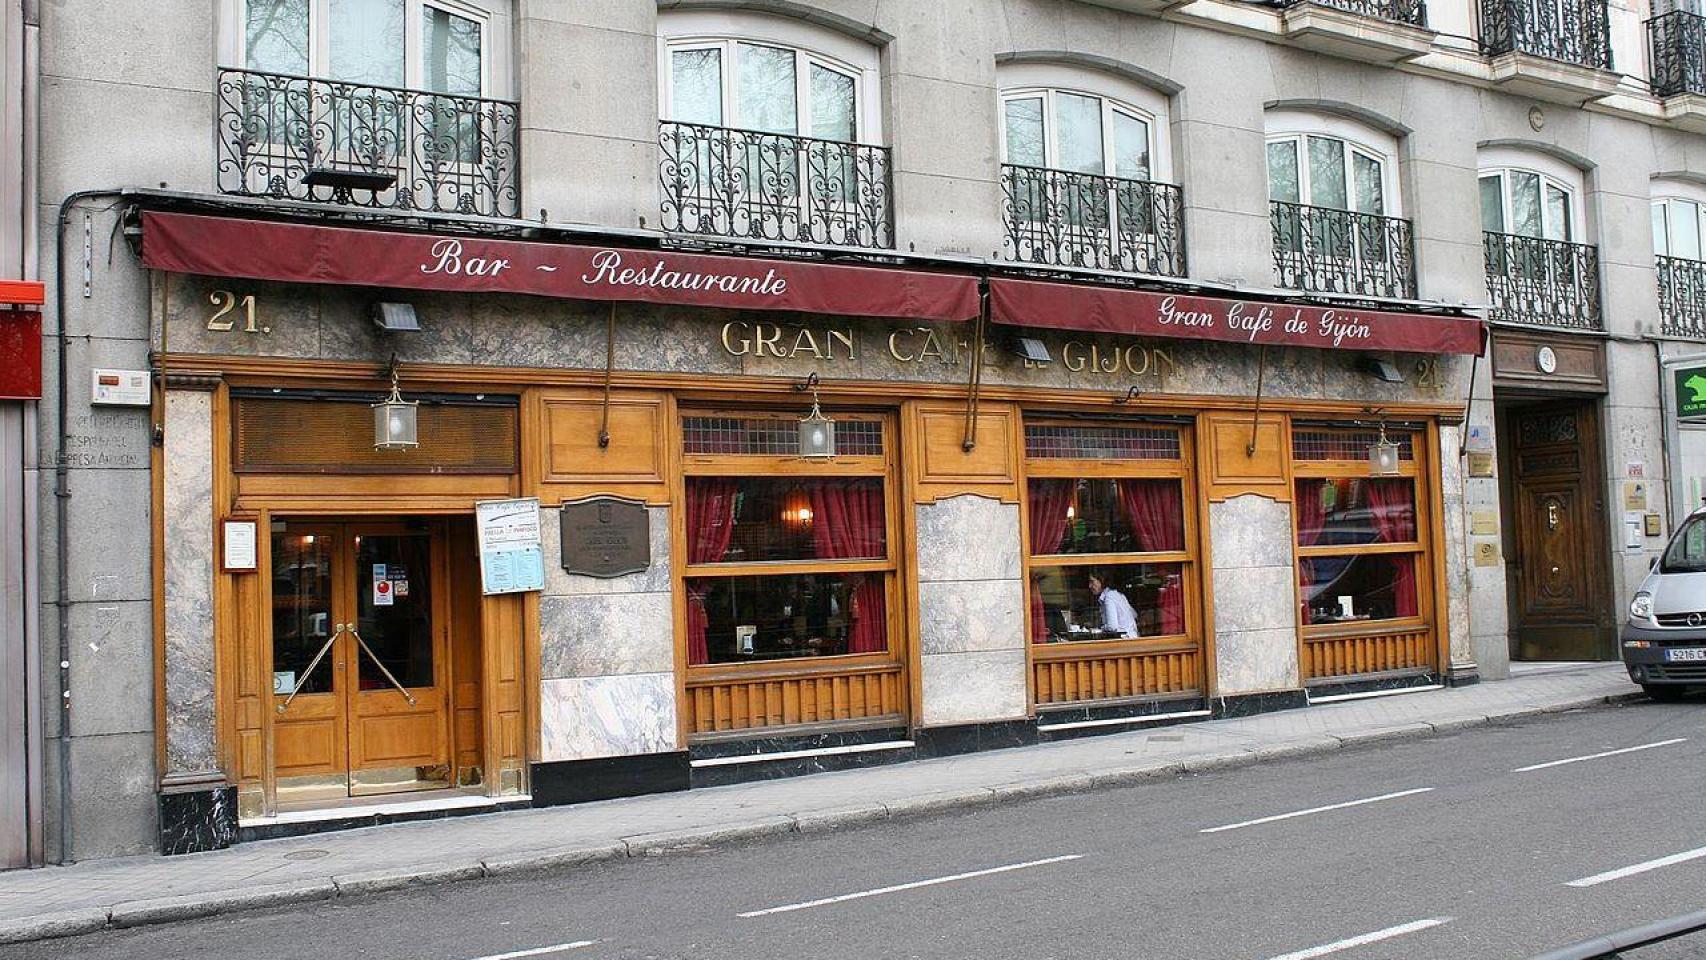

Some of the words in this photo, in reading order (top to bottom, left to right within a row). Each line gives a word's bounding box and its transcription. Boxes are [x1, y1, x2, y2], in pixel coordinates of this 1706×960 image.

[420, 239, 511, 277] Bar
[581, 250, 787, 295] Restaurante
[721, 320, 855, 360] GRAN
[1158, 296, 1214, 328] Gran
[1227, 303, 1273, 341] Café
[1285, 309, 1308, 333] de
[1318, 311, 1371, 347] Gijón
